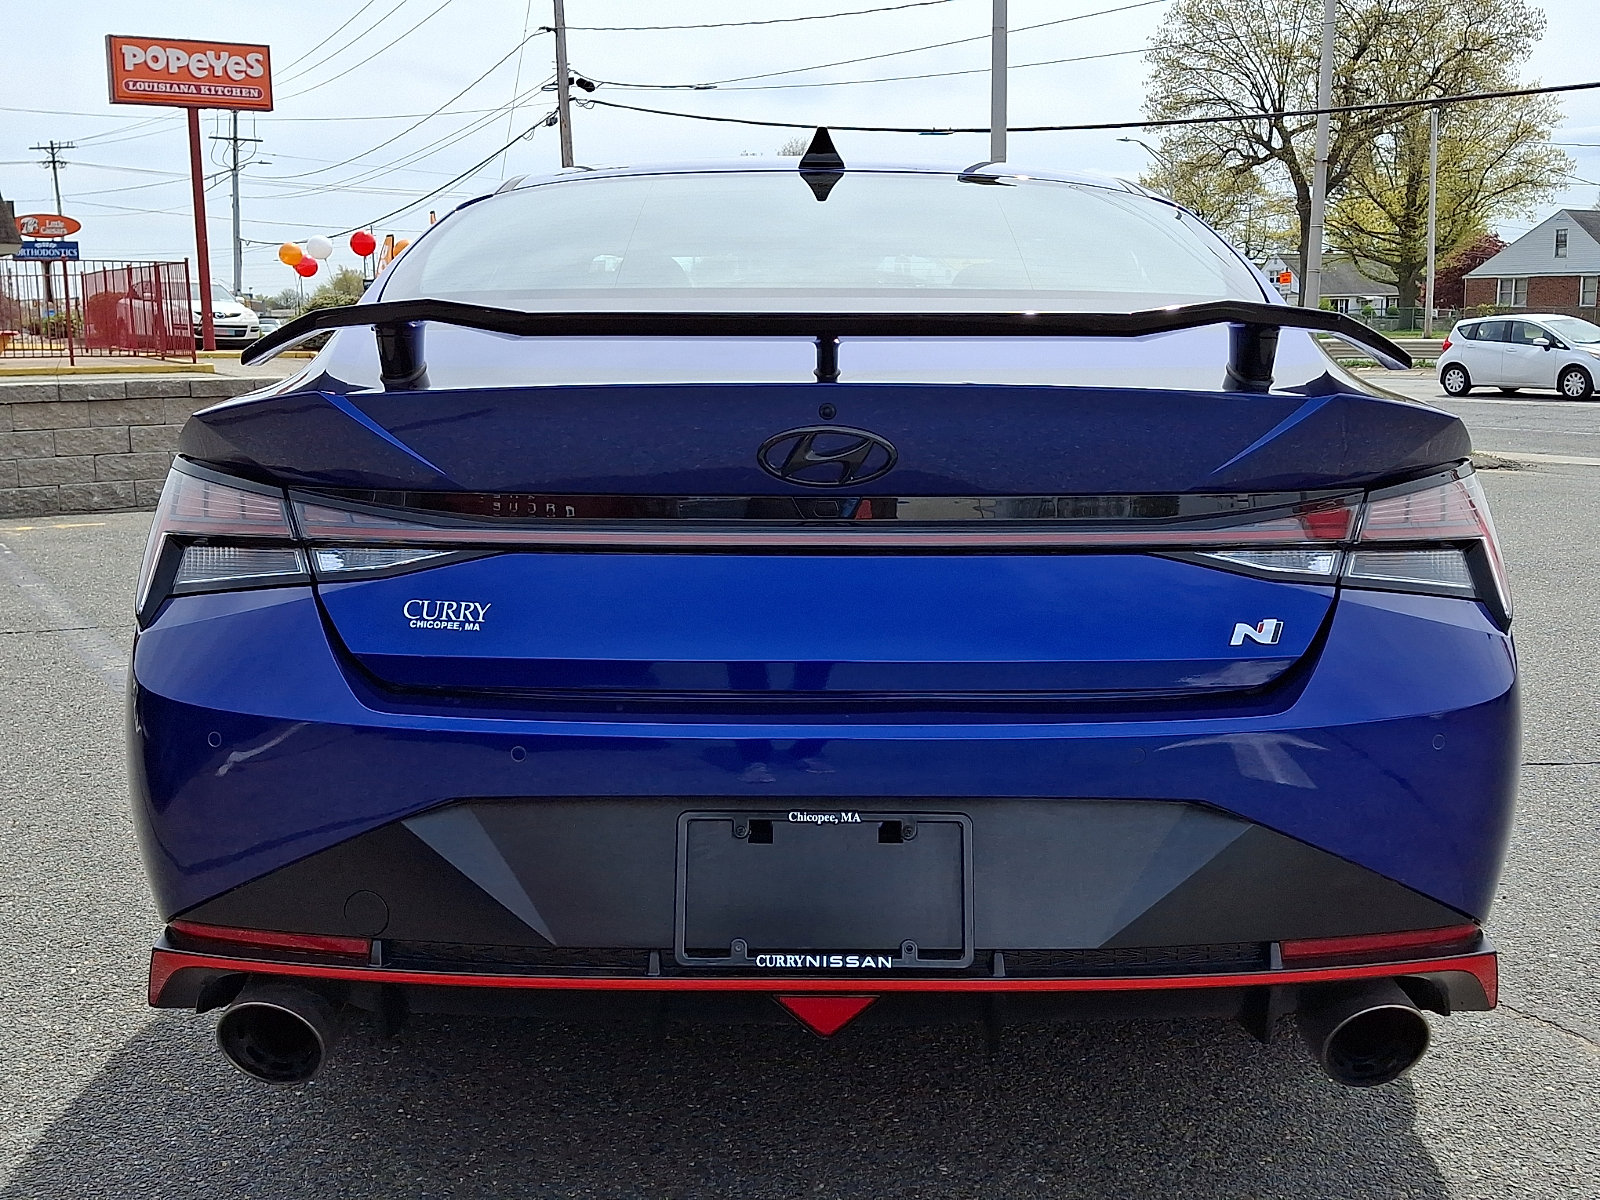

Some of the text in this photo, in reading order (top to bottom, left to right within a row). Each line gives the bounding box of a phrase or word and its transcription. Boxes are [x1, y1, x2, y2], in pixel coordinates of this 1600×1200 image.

[128, 81, 259, 98] LOUISIANA KITCHEN
[403, 599, 492, 622] CURRY
[409, 620, 480, 631] CHICOPEE, MA
[788, 811, 861, 825] Chicopee, MA
